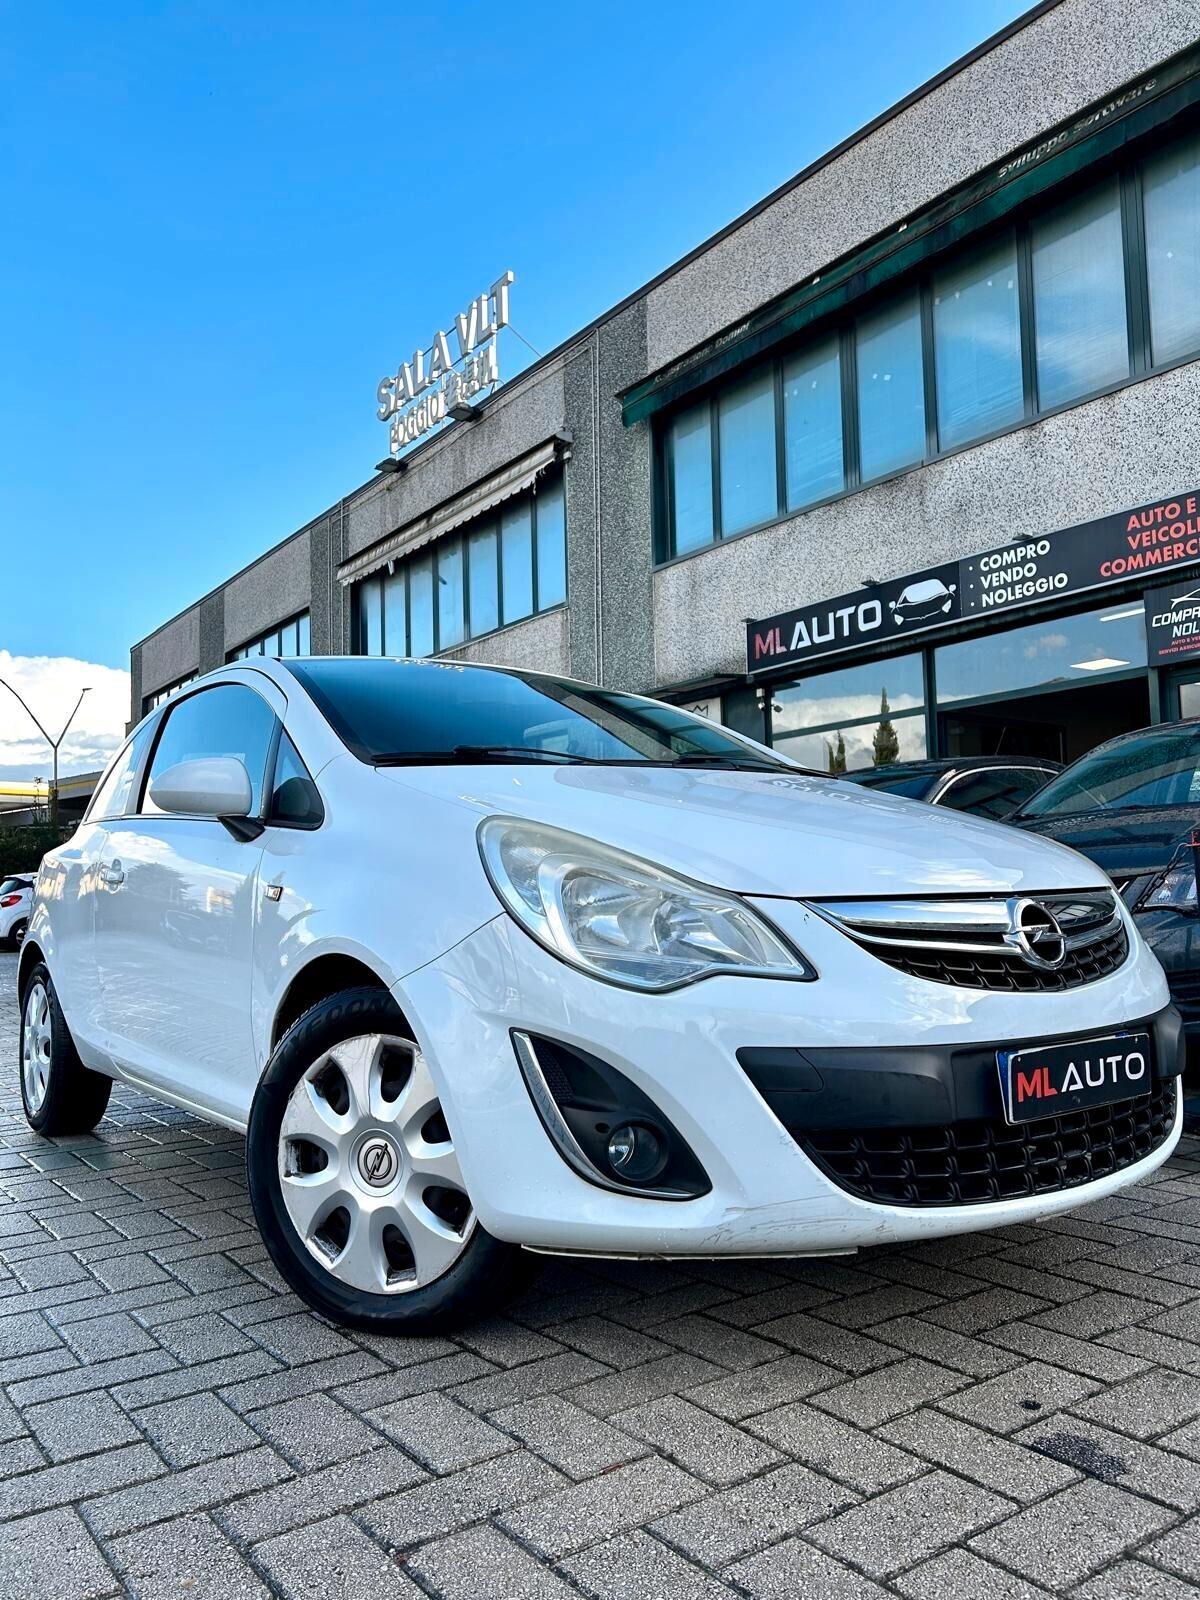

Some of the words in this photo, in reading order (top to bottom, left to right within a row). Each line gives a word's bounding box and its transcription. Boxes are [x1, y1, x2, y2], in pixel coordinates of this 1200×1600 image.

[377, 331, 452, 422] SALA
[455, 270, 514, 357] VLT
[389, 391, 446, 454] POGGIO
[1127, 502, 1181, 531] AUTO
[1186, 497, 1197, 514] E
[980, 540, 1051, 573] COMPRO
[1100, 538, 1200, 577] COMMERC
[980, 562, 1037, 590] VENDO
[981, 572, 1069, 608] NOLEGGIO
